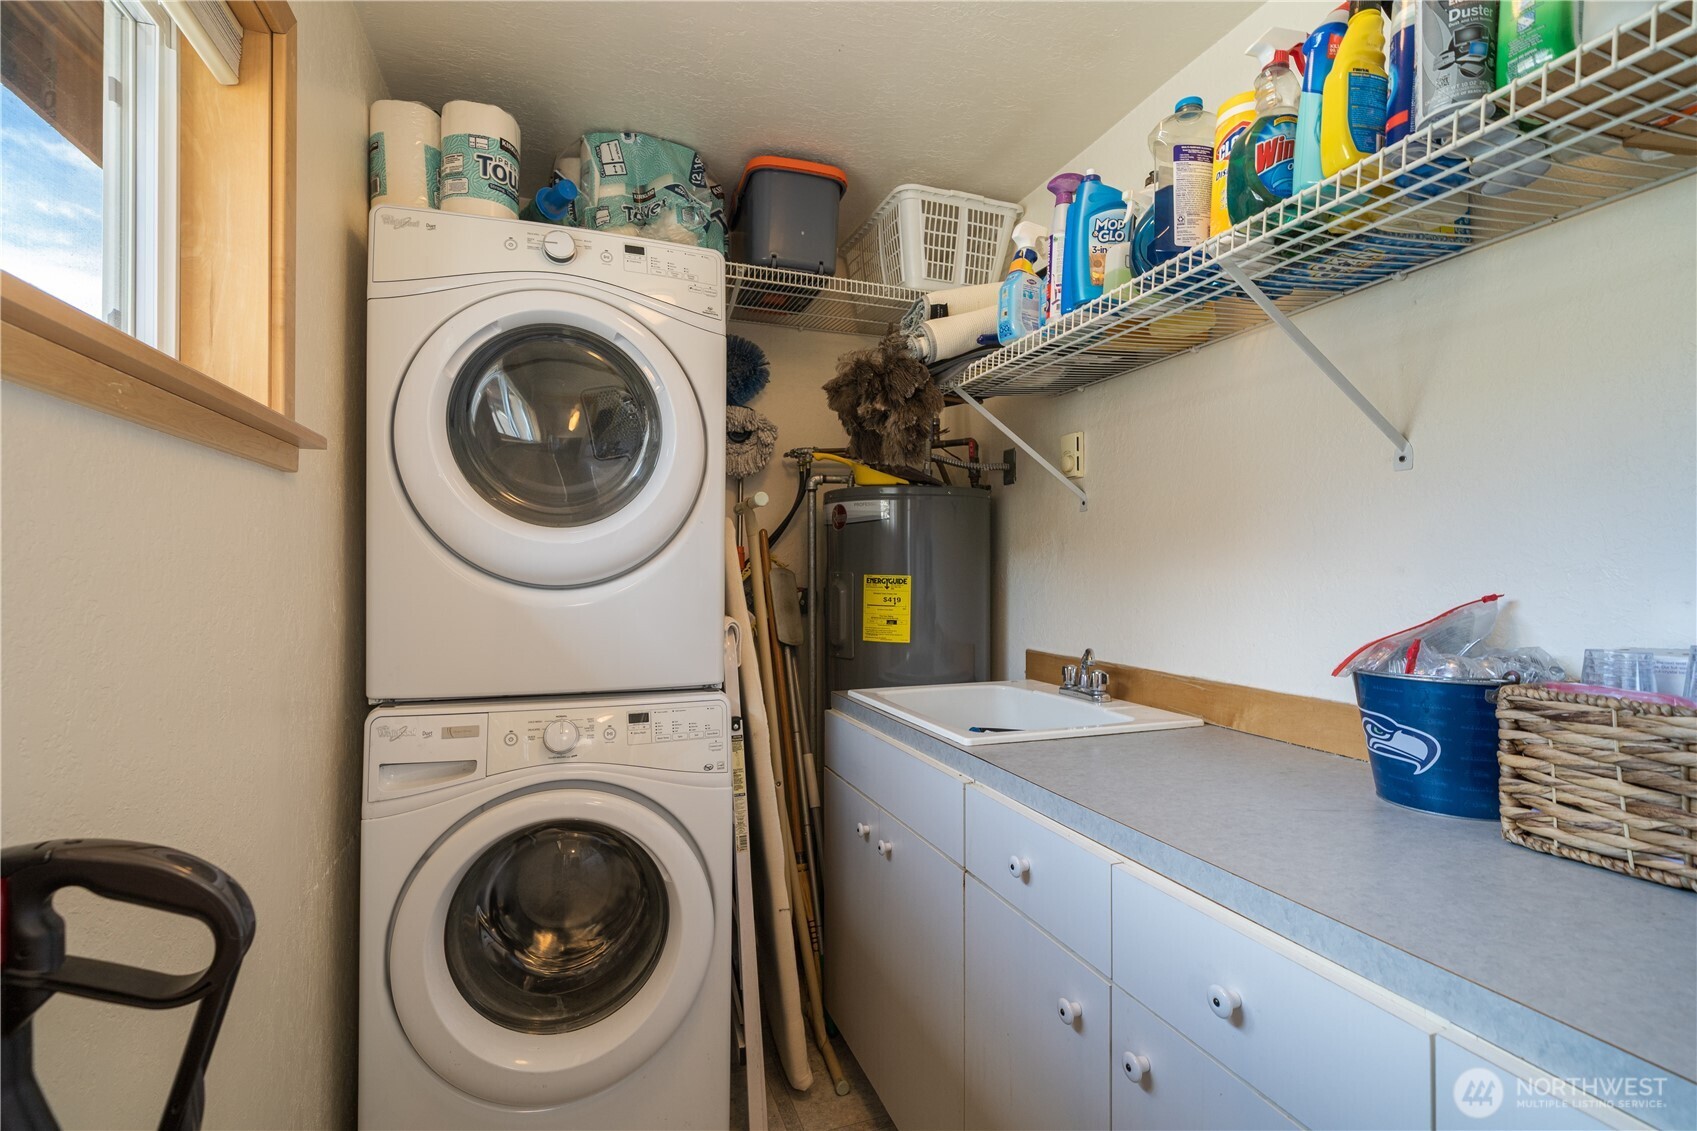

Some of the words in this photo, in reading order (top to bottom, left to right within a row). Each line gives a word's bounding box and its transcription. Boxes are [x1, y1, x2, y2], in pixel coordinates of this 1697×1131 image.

[1449, 4, 1494, 22] Duster
[633, 189, 655, 199] KIRKLAND
[1095, 217, 1126, 231] MOP
[1098, 228, 1125, 242] GLO
